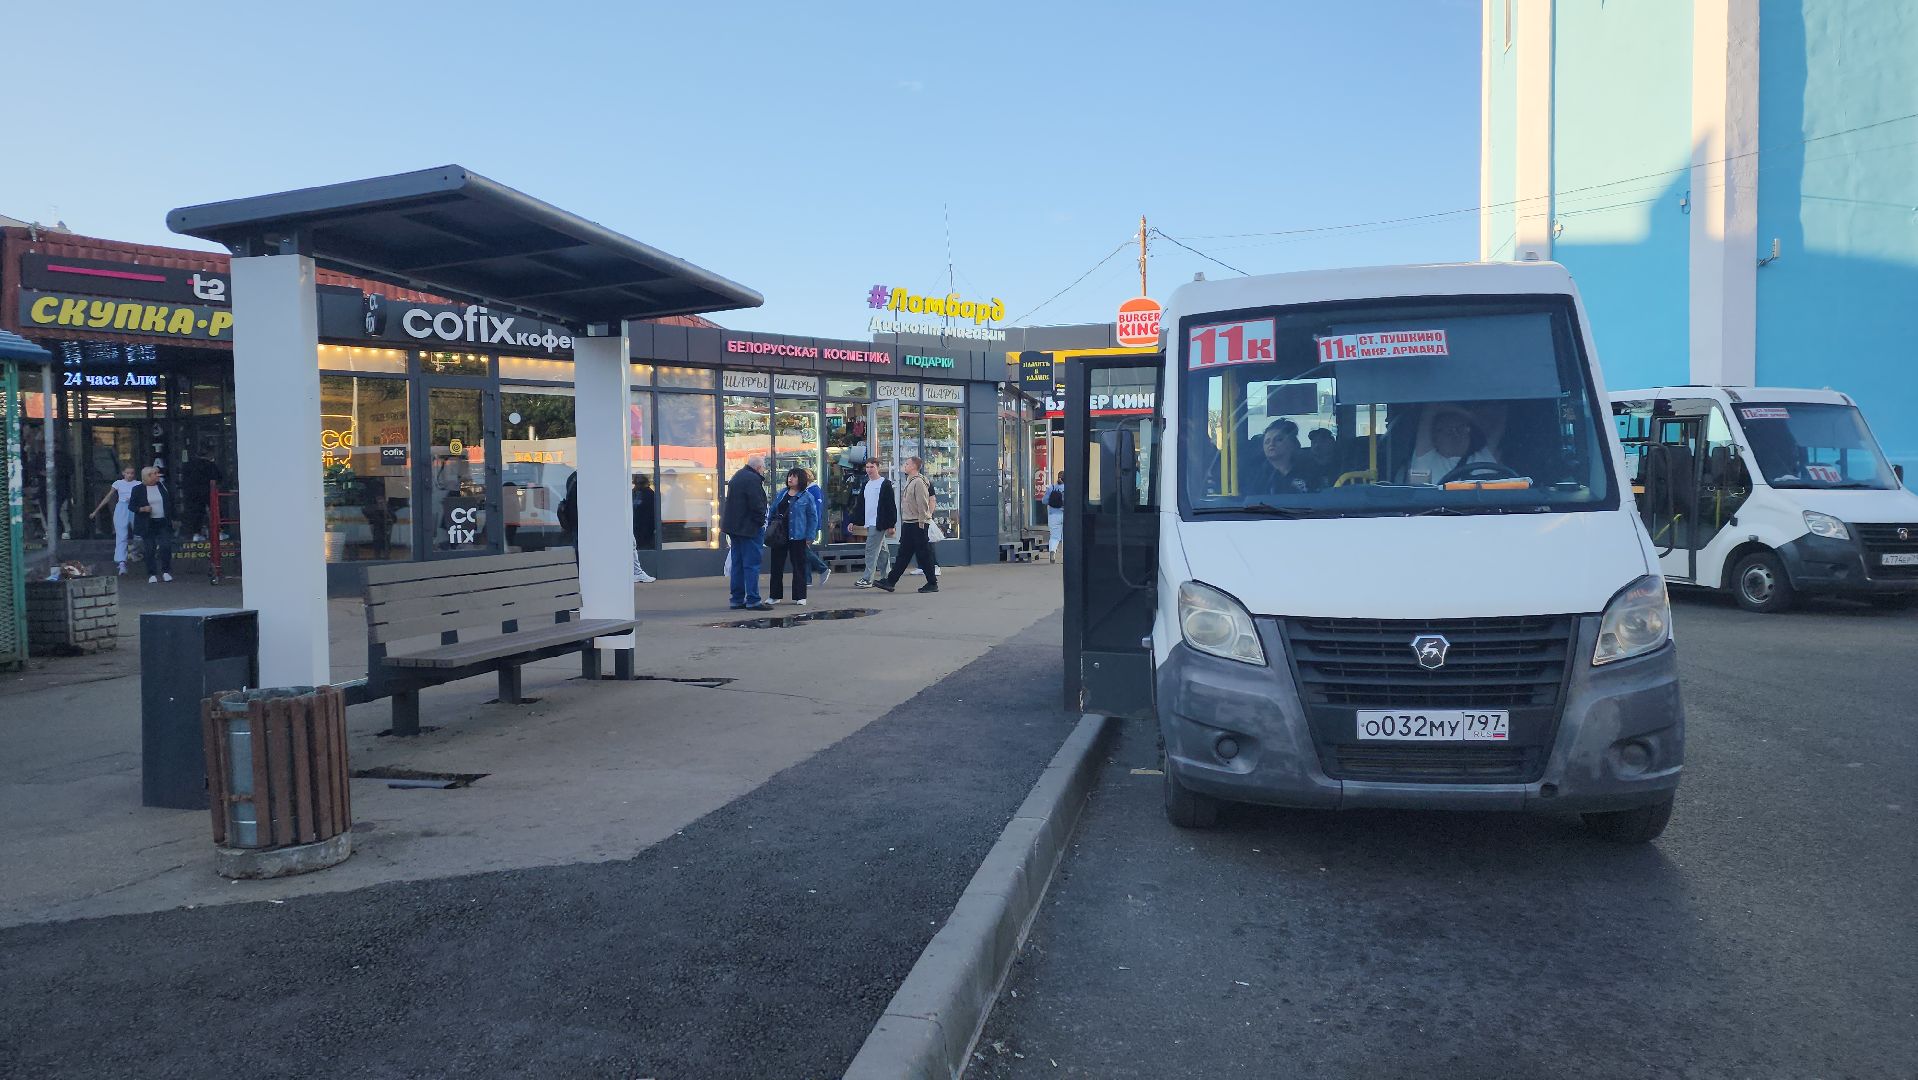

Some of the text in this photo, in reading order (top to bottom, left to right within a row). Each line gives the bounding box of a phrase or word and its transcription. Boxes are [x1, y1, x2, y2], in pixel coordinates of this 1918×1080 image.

[867, 284, 1006, 325] #Ломбард
[1119, 312, 1160, 323] BURGER
[402, 305, 575, 353] cofix кофе
[1119, 322, 1159, 337] KING
[1379, 331, 1443, 345] ПУШКИНО
[727, 340, 891, 364] БЕЛОРУССКАЯ КОСМЕТИКА
[1392, 344, 1447, 356] АРМАНД
[905, 354, 955, 369] ПОДАРКИ
[63, 372, 82, 386] 24
[85, 375, 119, 386] часа
[723, 375, 769, 389] ШАРЫ
[774, 378, 816, 392] ШАРЫ
[878, 384, 917, 398] СВЕЧИ
[1045, 394, 1110, 411] БУЕР
[382, 447, 405, 457] cofix
[447, 524, 475, 544] fix
[1464, 714, 1502, 731] 797
